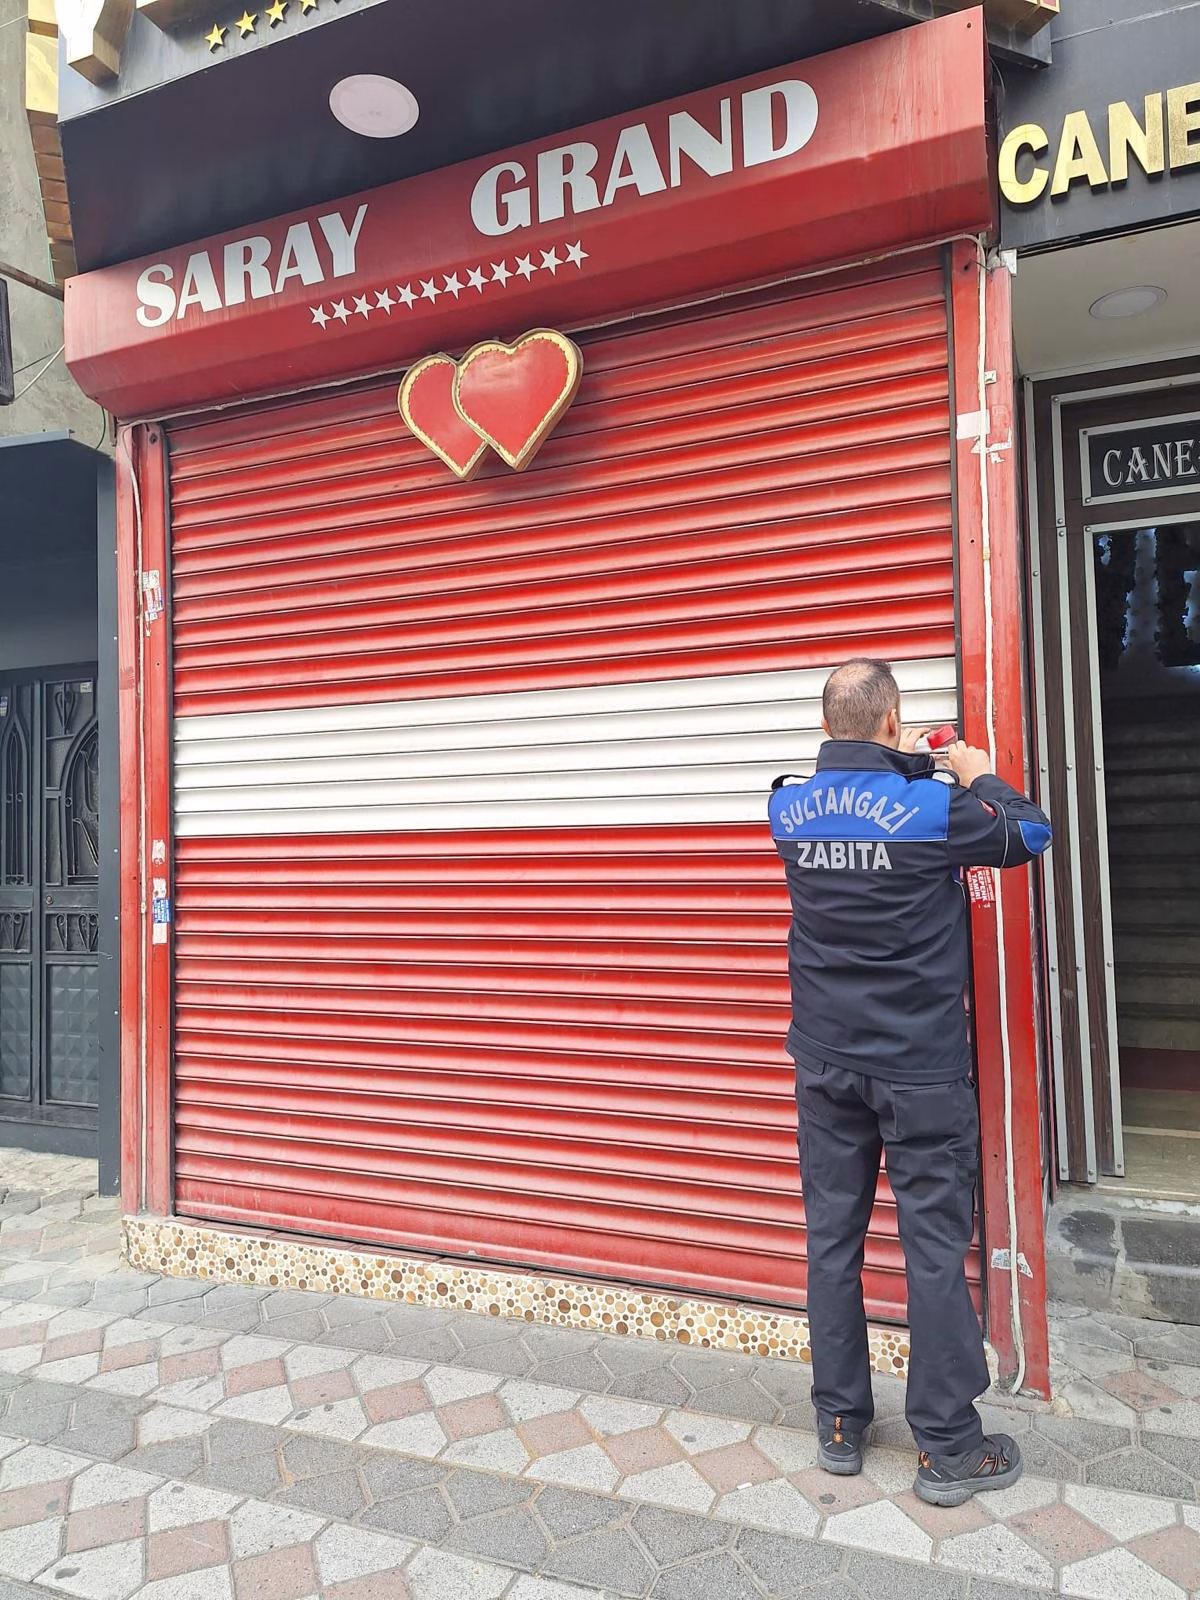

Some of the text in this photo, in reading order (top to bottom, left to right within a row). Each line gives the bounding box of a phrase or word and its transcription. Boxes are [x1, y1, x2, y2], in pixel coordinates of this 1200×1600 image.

[135, 79, 819, 328] SARAY GRAND
[1103, 439, 1200, 487] CANE
[779, 786, 920, 834] SULTANGAZİ
[797, 842, 892, 870] ZABITA
